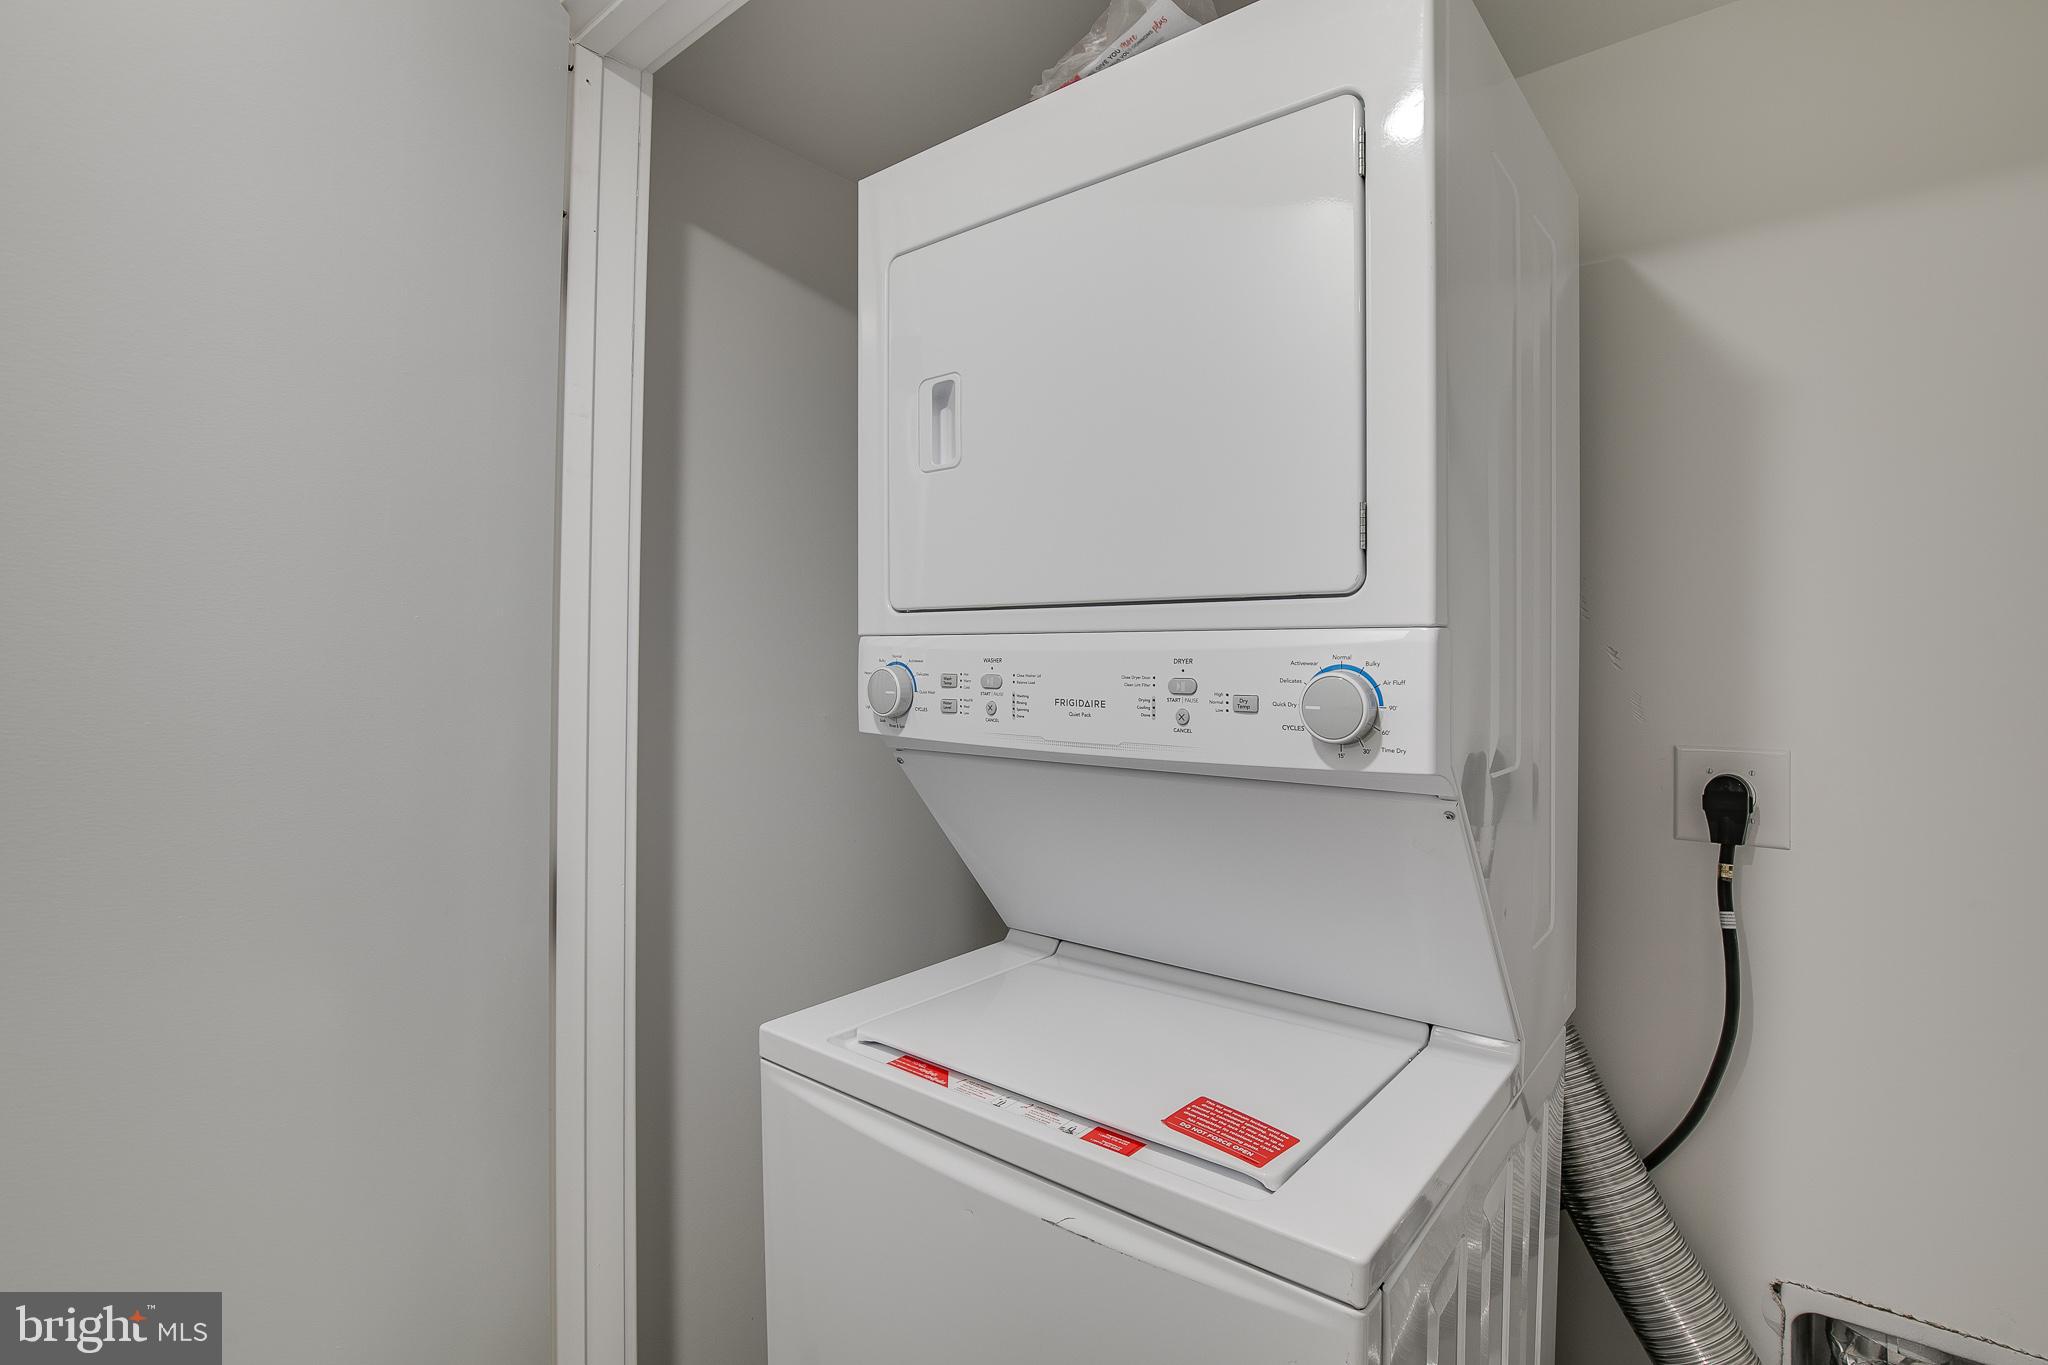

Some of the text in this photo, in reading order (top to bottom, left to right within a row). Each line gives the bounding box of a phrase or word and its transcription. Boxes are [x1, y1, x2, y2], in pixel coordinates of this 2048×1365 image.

[1152, 16, 1168, 33] plus
[1107, 49, 1121, 61] YOU
[1054, 698, 1106, 709] FRIGIDAIRE
[1179, 1121, 1254, 1157] DO NOT FORCE OPEN
